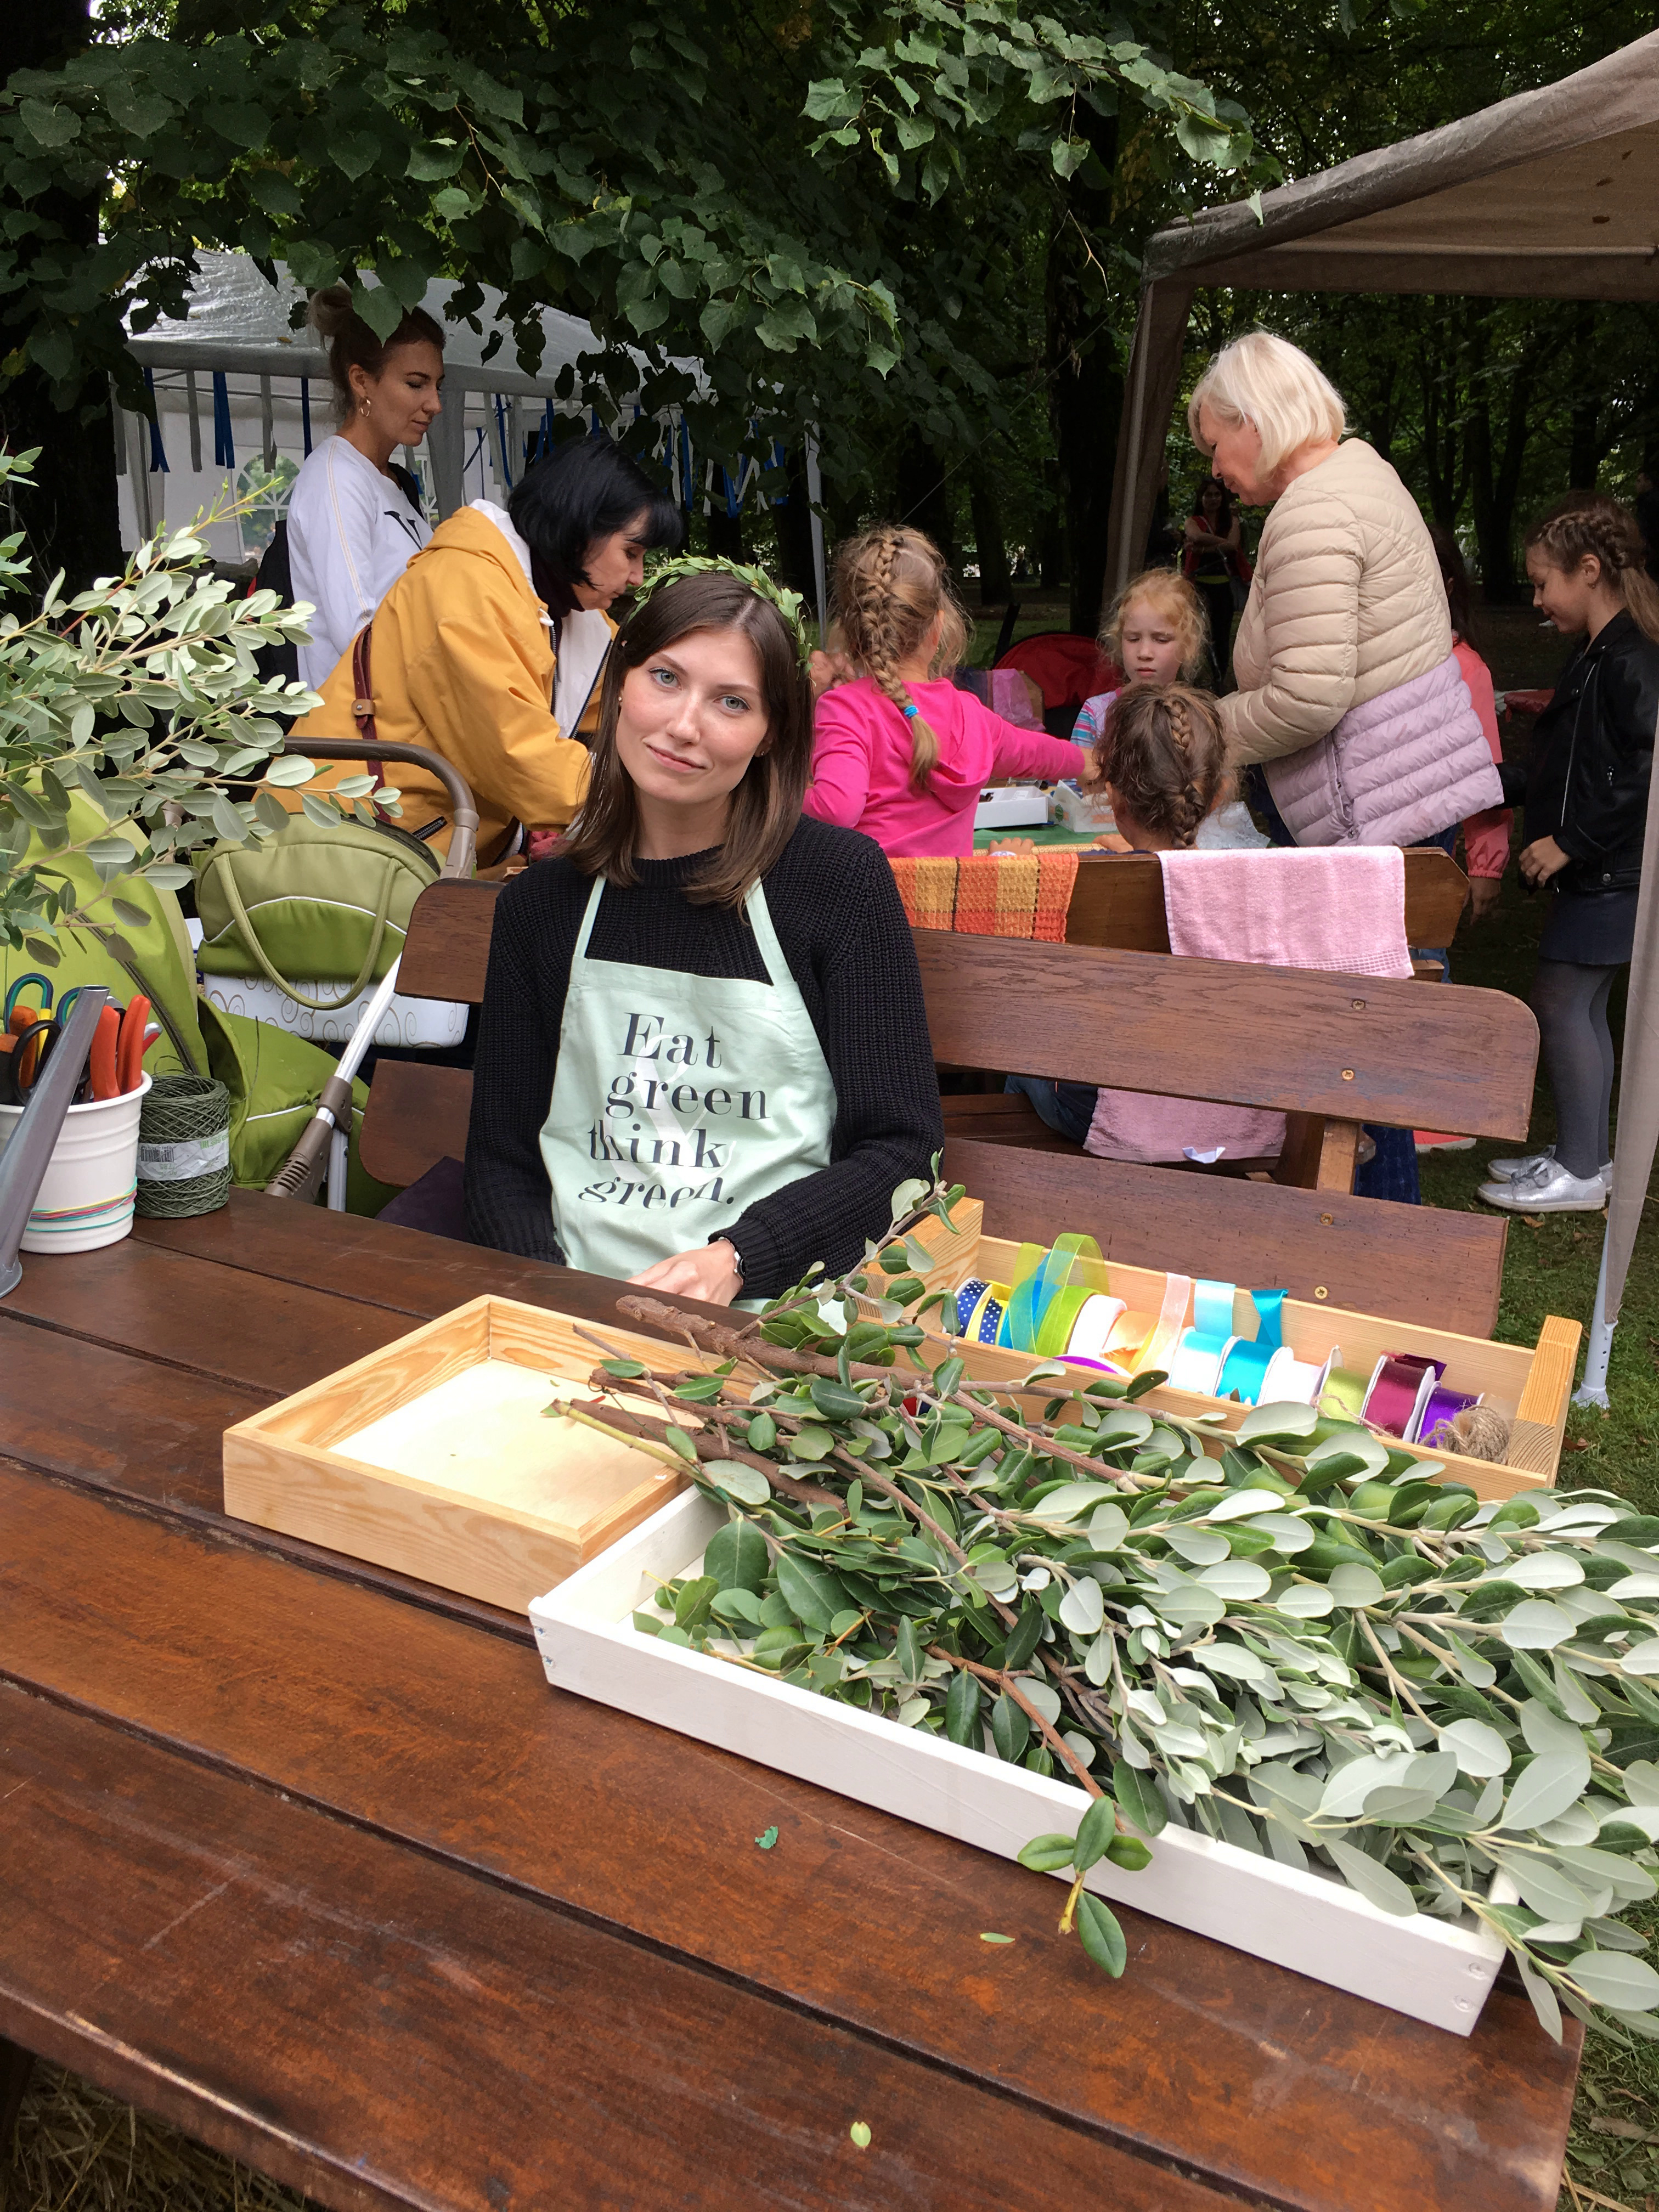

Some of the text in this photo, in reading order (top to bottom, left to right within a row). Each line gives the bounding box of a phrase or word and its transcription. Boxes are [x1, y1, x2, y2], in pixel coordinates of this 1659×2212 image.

[617, 1012, 722, 1069] Eat
[605, 1071, 771, 1120] green
[588, 1119, 727, 1169] think
